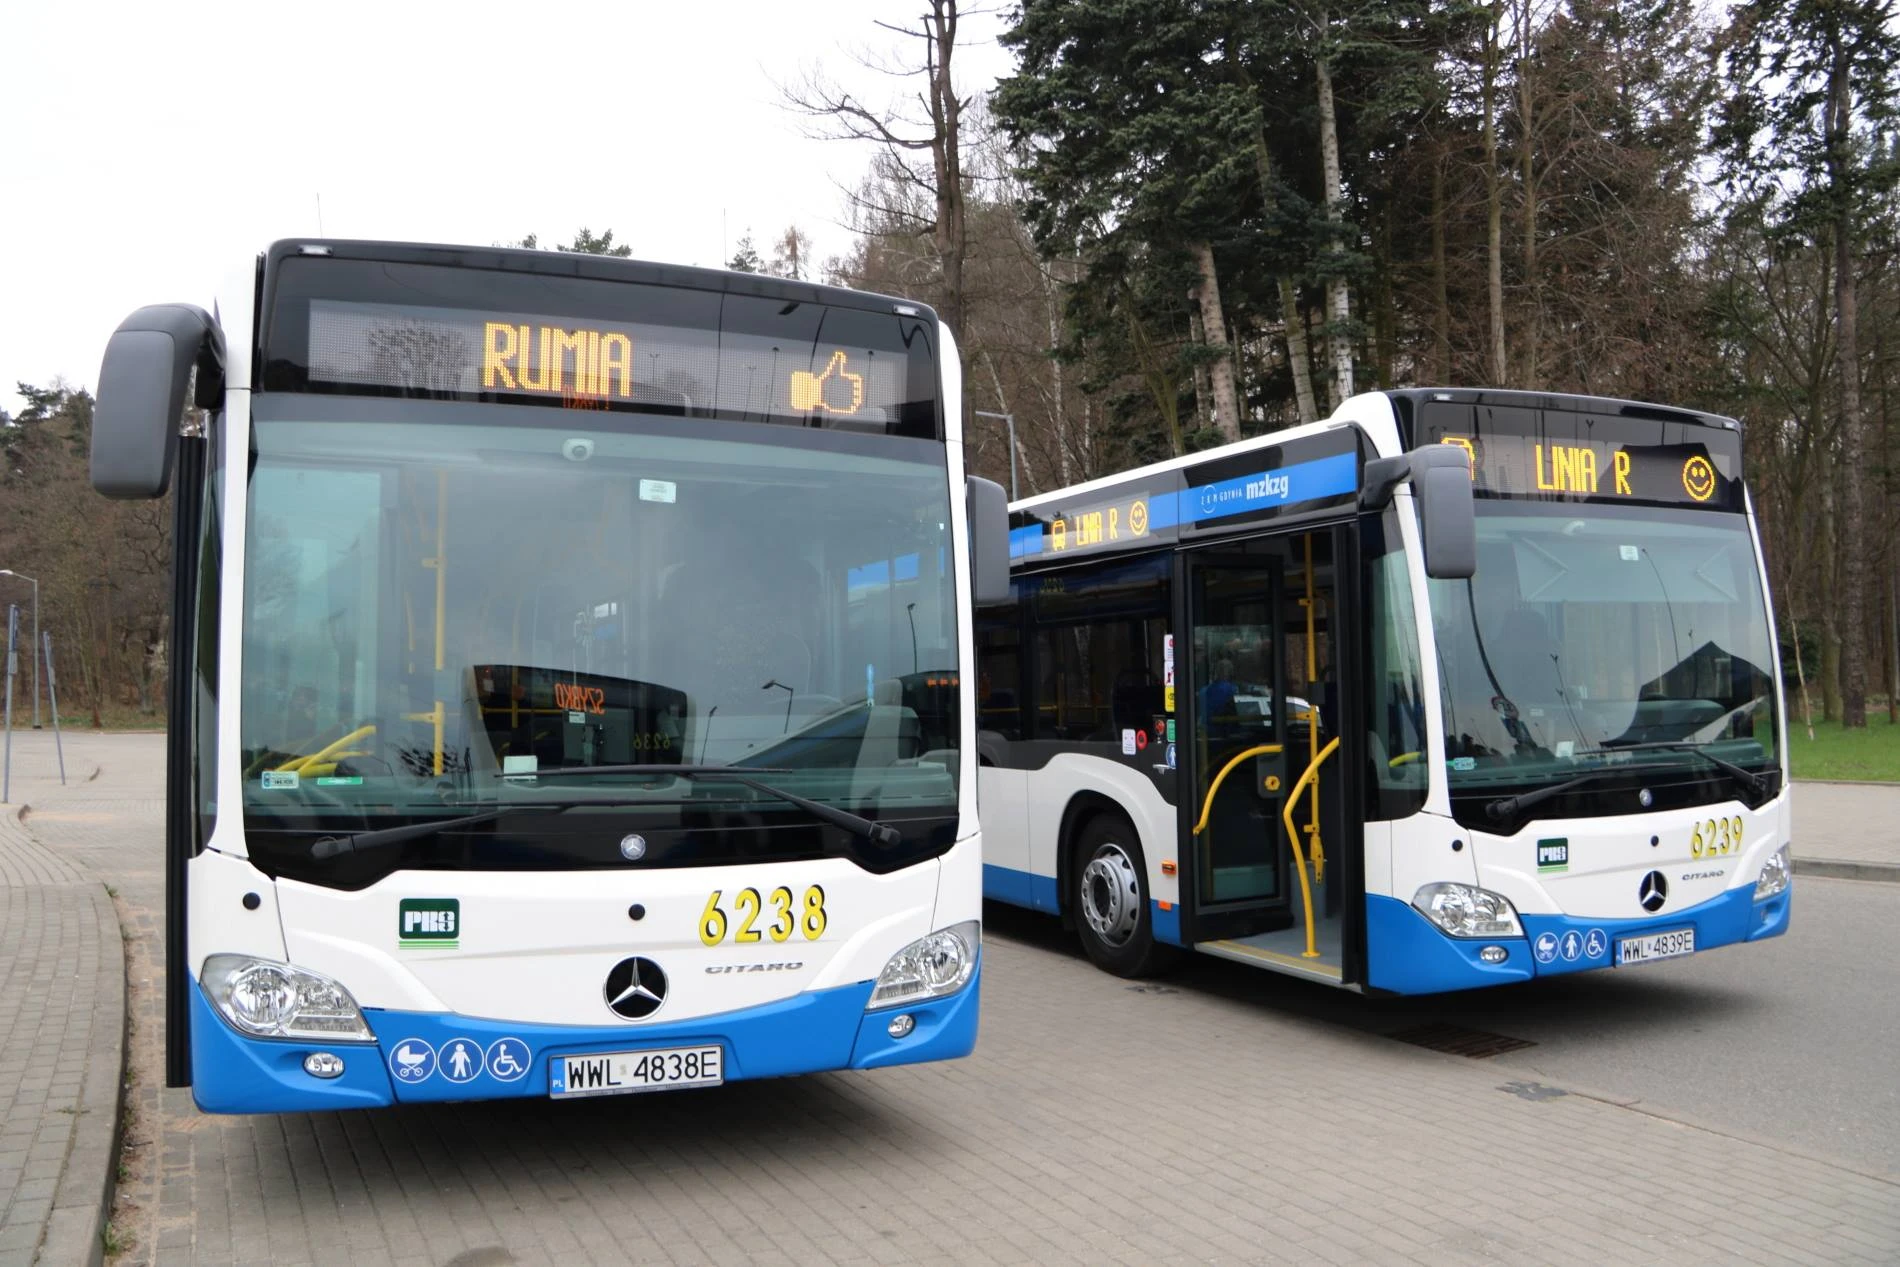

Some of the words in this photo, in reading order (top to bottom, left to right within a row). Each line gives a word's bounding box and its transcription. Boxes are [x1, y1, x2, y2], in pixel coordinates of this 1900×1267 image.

[484, 322, 632, 397] RUMIA
[1535, 444, 1598, 493] LINIA
[1613, 451, 1632, 495] R
[1246, 473, 1289, 500] mzkzg
[1109, 507, 1118, 539] R
[1691, 815, 1743, 860] 6239
[1682, 870, 1724, 881] CITARO
[405, 911, 455, 932] PKS
[699, 884, 827, 947] 6238
[1623, 940, 1648, 960] WWL
[1653, 931, 1692, 955] 4839E
[705, 962, 804, 974] CITARO
[552, 1079, 564, 1089] PL
[568, 1059, 621, 1089] WWL
[633, 1051, 717, 1083] 4838E
